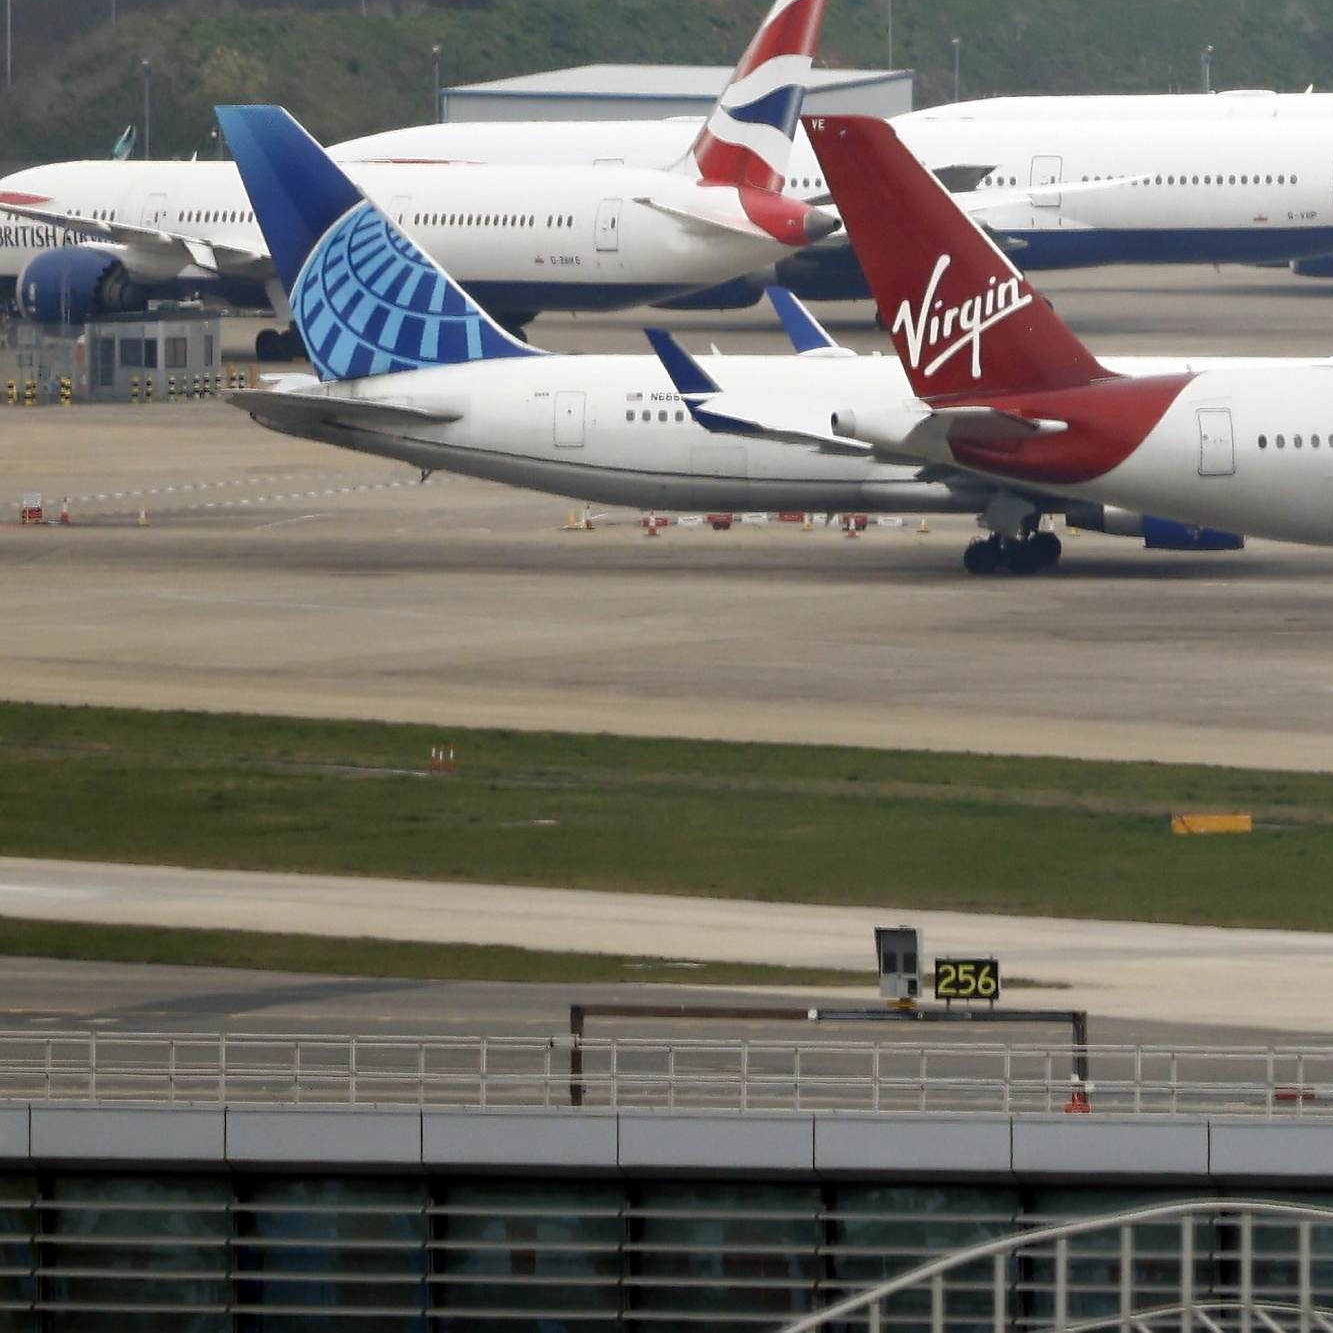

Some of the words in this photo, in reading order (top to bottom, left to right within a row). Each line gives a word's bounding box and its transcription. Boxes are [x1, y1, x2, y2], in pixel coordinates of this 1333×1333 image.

[811, 118, 825, 131] VE
[892, 253, 1033, 379] Virgin
[938, 964, 997, 995] 256
